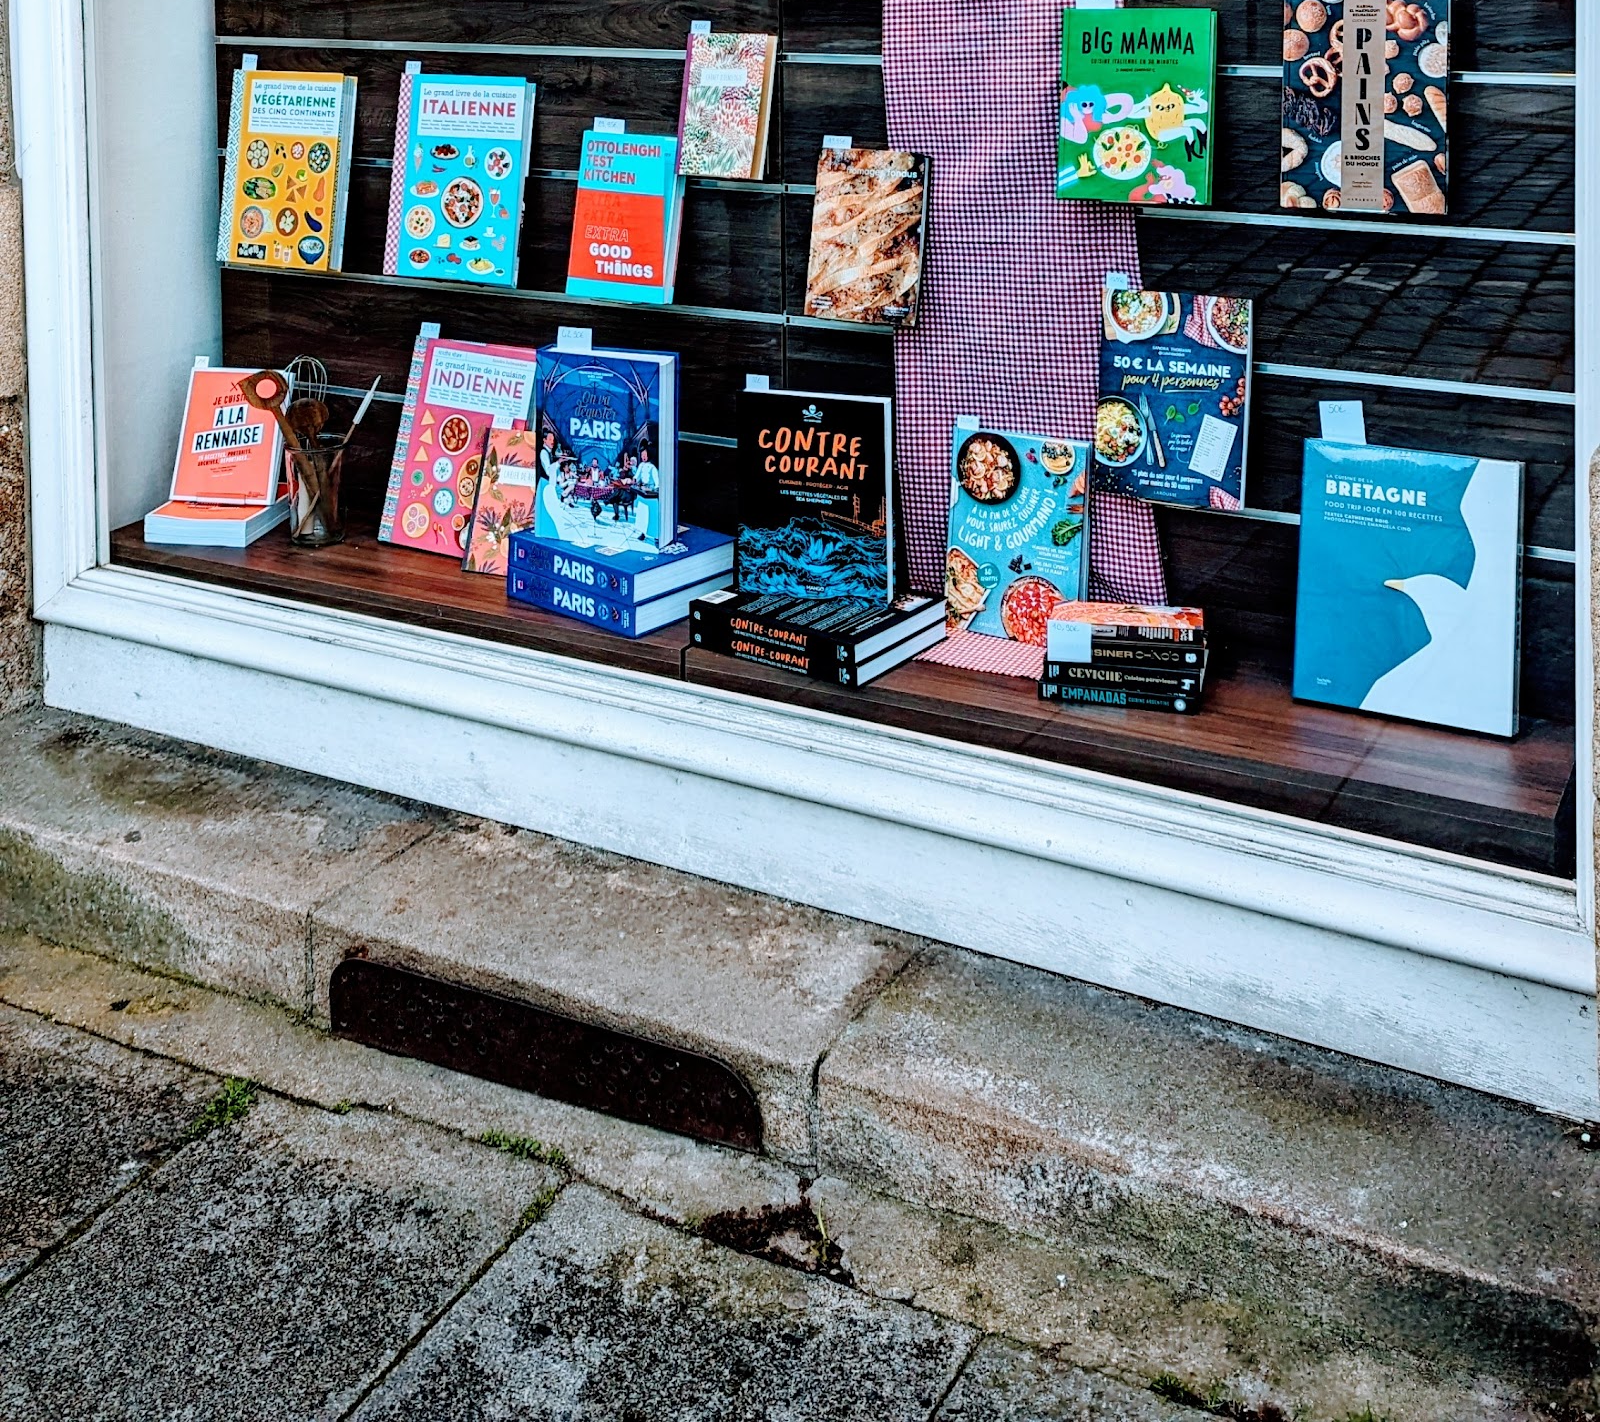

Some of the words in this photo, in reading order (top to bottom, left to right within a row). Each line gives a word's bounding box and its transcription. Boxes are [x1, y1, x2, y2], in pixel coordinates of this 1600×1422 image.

[1082, 27, 1113, 54] BIG
[1120, 26, 1195, 55] MAMMA
[263, 82, 281, 91] grand
[283, 82, 296, 91] livre
[298, 83, 306, 91] de
[314, 84, 337, 92] cuisine
[423, 88, 432, 96] Le
[434, 89, 454, 97] grand
[455, 89, 471, 97] livre
[472, 89, 482, 98] de
[483, 90, 490, 98] la
[491, 90, 517, 99] cuisine
[254, 91, 336, 109] VÉGÉTARIENNE
[422, 99, 516, 118] ITALIENNE
[268, 107, 287, 116] CINQ
[289, 109, 335, 118] CONTINENTS
[587, 140, 661, 158] OTTOLENGHI
[586, 154, 614, 167] TEST
[584, 170, 635, 185] KITCHEN
[585, 225, 629, 242] EXTRA
[589, 243, 632, 259] GOOD
[435, 358, 444, 366] Le
[445, 361, 465, 370] grand
[466, 363, 482, 373] livre
[484, 366, 493, 374] de
[493, 367, 500, 376] la
[501, 370, 526, 380] cuisine
[1147, 359, 1165, 372] LA
[1168, 360, 1231, 378] SEMAINE
[432, 368, 524, 399] INDIENNE
[1121, 373, 1150, 391] pour
[1151, 373, 1160, 387] 4
[213, 396, 222, 406] JE
[582, 390, 596, 405] On
[215, 406, 224, 427] À
[229, 406, 244, 424] LA
[1328, 403, 1346, 414] 50€
[570, 417, 622, 441] PARIS
[195, 426, 260, 452] RENNAISE
[758, 426, 862, 458] CONTRE
[764, 455, 869, 480] COURANT
[1334, 474, 1357, 483] CUISINE
[789, 490, 813, 498] RECETTES
[1325, 479, 1427, 507] BRETAGNE
[966, 514, 986, 531] VOUS
[989, 518, 1018, 533] SAUREZ
[1018, 488, 1041, 522] CUISINER
[978, 509, 987, 518] LA
[1324, 500, 1345, 509] FOOD
[1347, 503, 1362, 511] TRIP
[1363, 504, 1380, 514] IODÉ
[1382, 508, 1393, 516] EN
[1394, 509, 1407, 518] 100
[1408, 512, 1443, 523] RECETTES
[995, 535, 1002, 552] &
[1006, 497, 1056, 550] GOURMAND
[553, 555, 595, 586] PARIS
[553, 586, 596, 618] PARIS
[730, 618, 808, 647] CONTRE-COURANT
[731, 640, 810, 669] CONTRE-COURANT
[1068, 667, 1123, 683] CEVICHE
[1061, 686, 1127, 705] EMPANADAS
